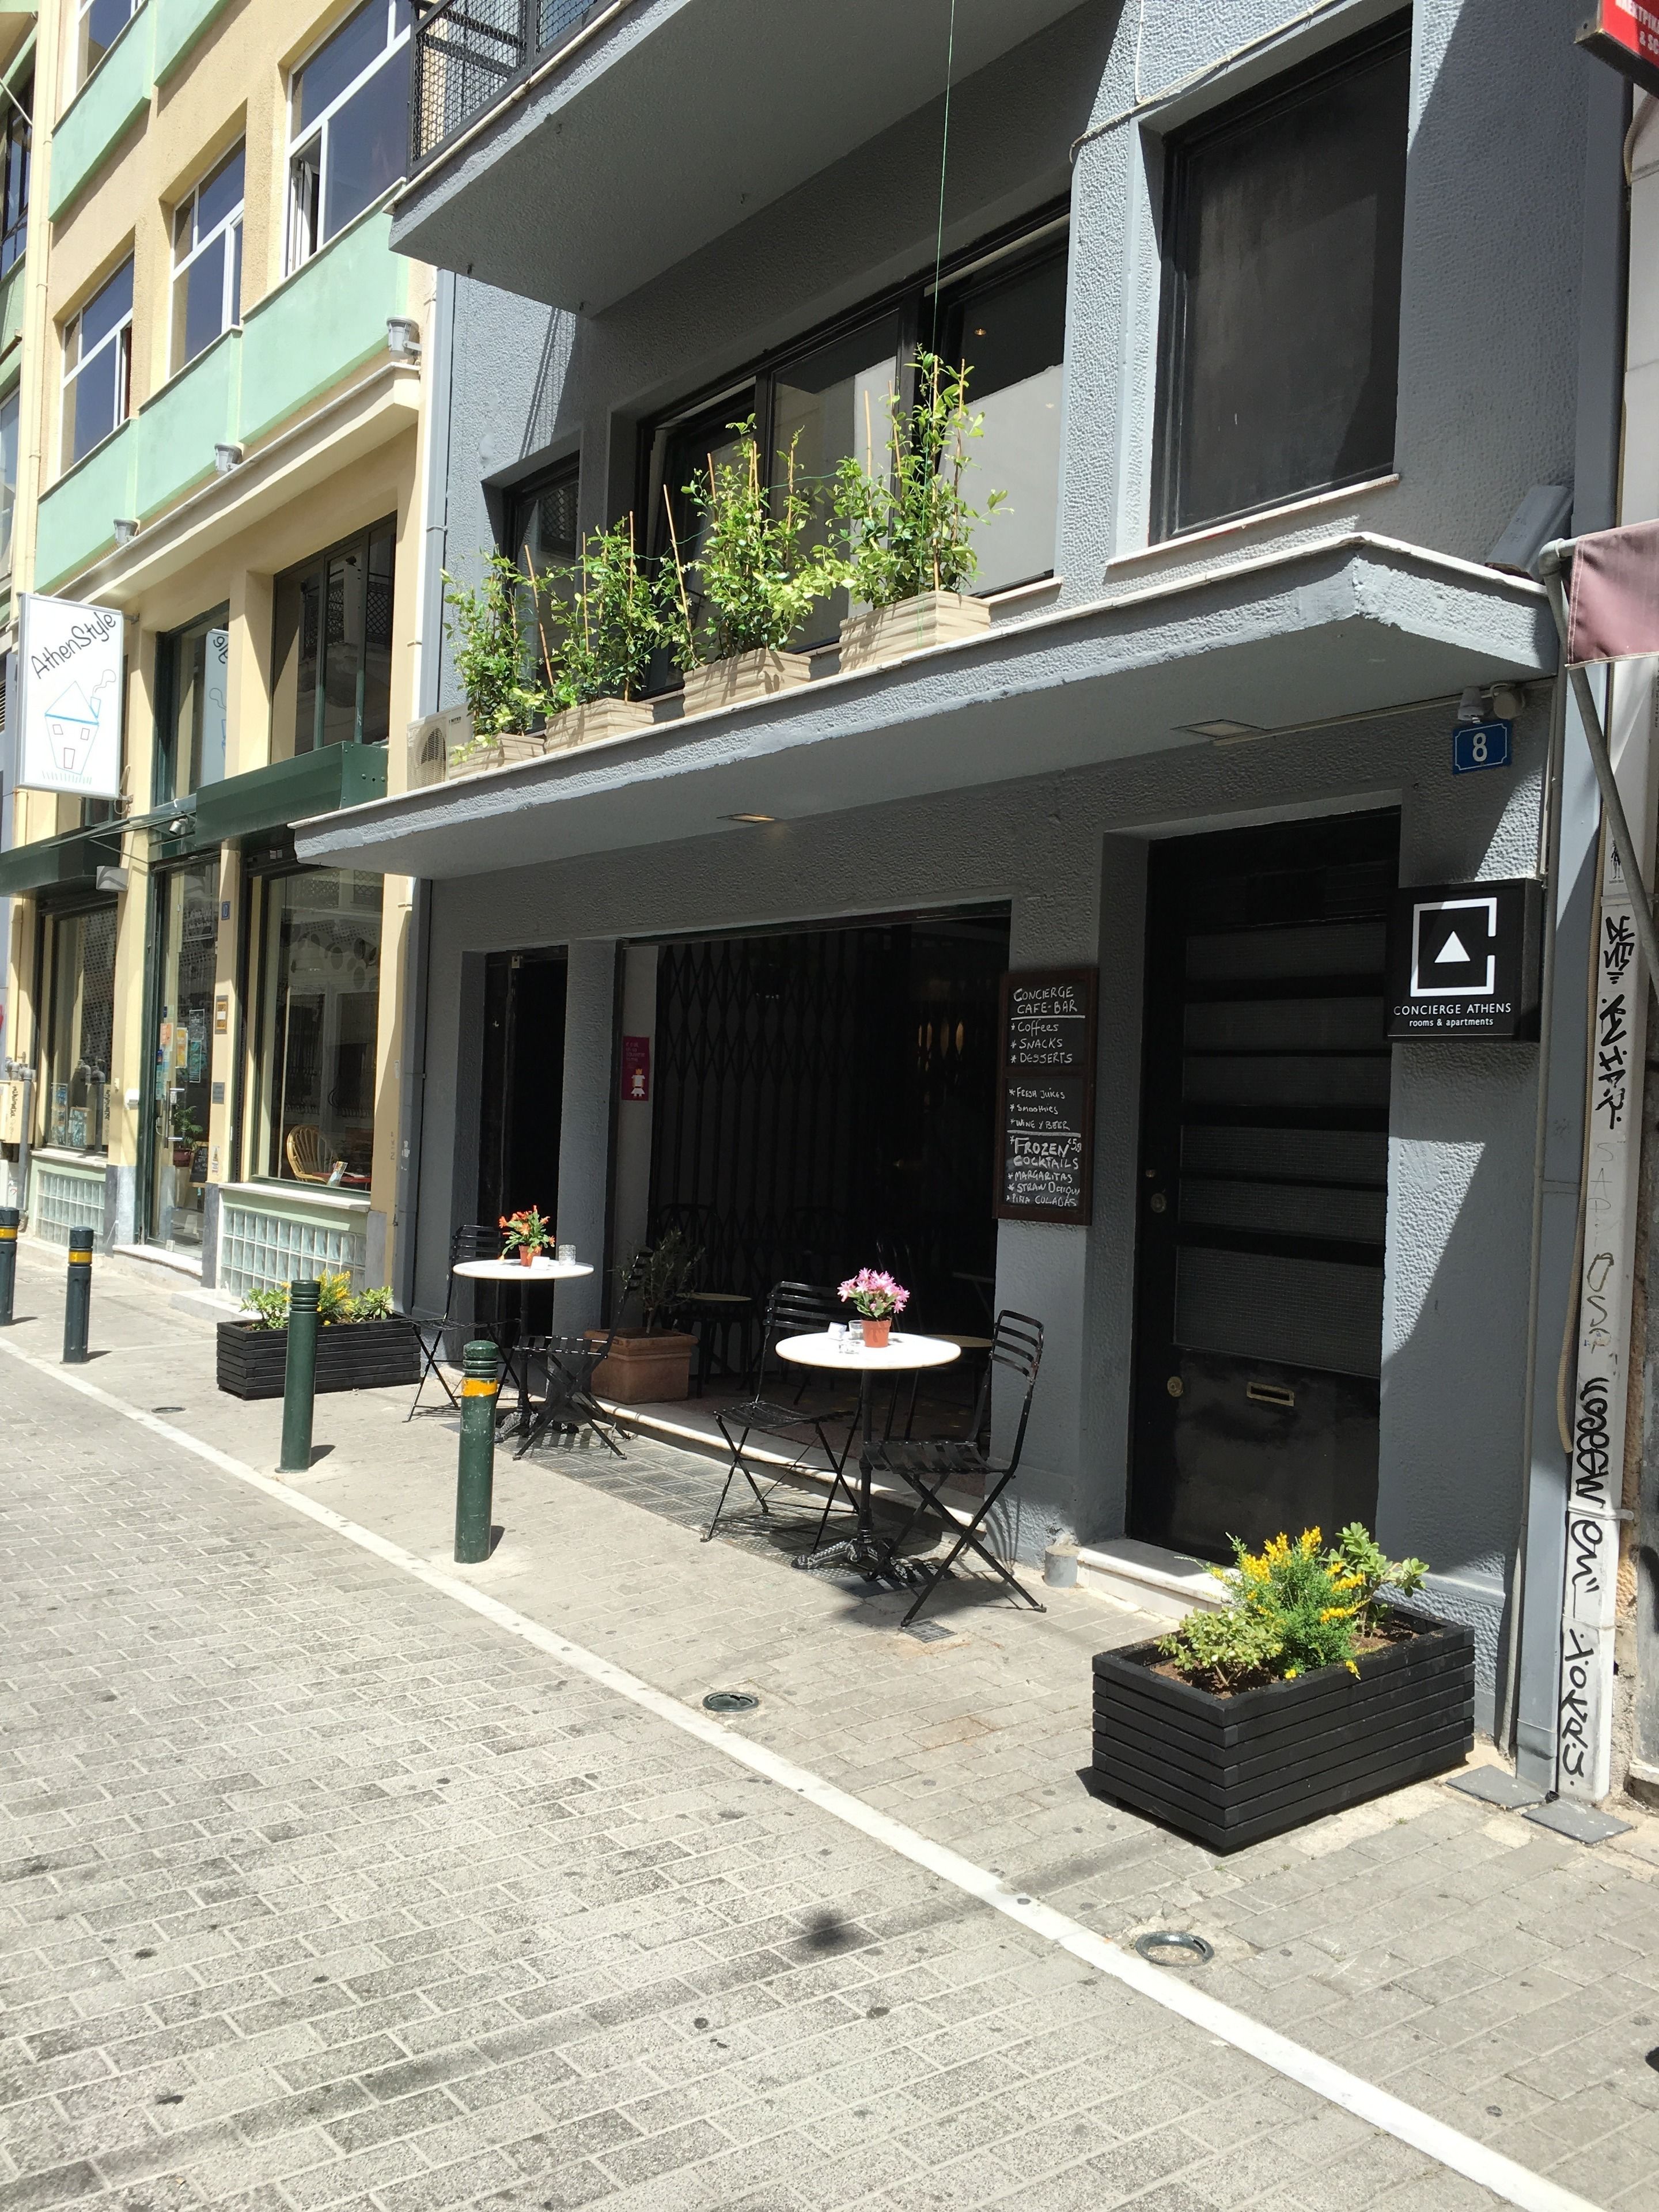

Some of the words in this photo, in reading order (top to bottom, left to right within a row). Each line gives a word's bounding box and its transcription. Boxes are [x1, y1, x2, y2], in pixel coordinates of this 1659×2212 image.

[31, 612, 116, 680] AthenStyle
[1472, 732, 1488, 762] 8
[1014, 986, 1074, 1002] CONCIERGE
[1393, 1004, 1461, 1016] CONCIERGE
[1467, 1003, 1512, 1014] ATHENS
[1018, 1018, 1059, 1037] Coffees
[1437, 1018, 1442, 1027] &
[1446, 1018, 1494, 1028] apartments
[1019, 1037, 1063, 1050] SNACKS
[1020, 1052, 1073, 1064] DESSERTS
[1014, 1137, 1069, 1158] FROZEN
[1014, 1155, 1078, 1170] COCKTAILS
[1015, 1170, 1073, 1183] MARGARITAS
